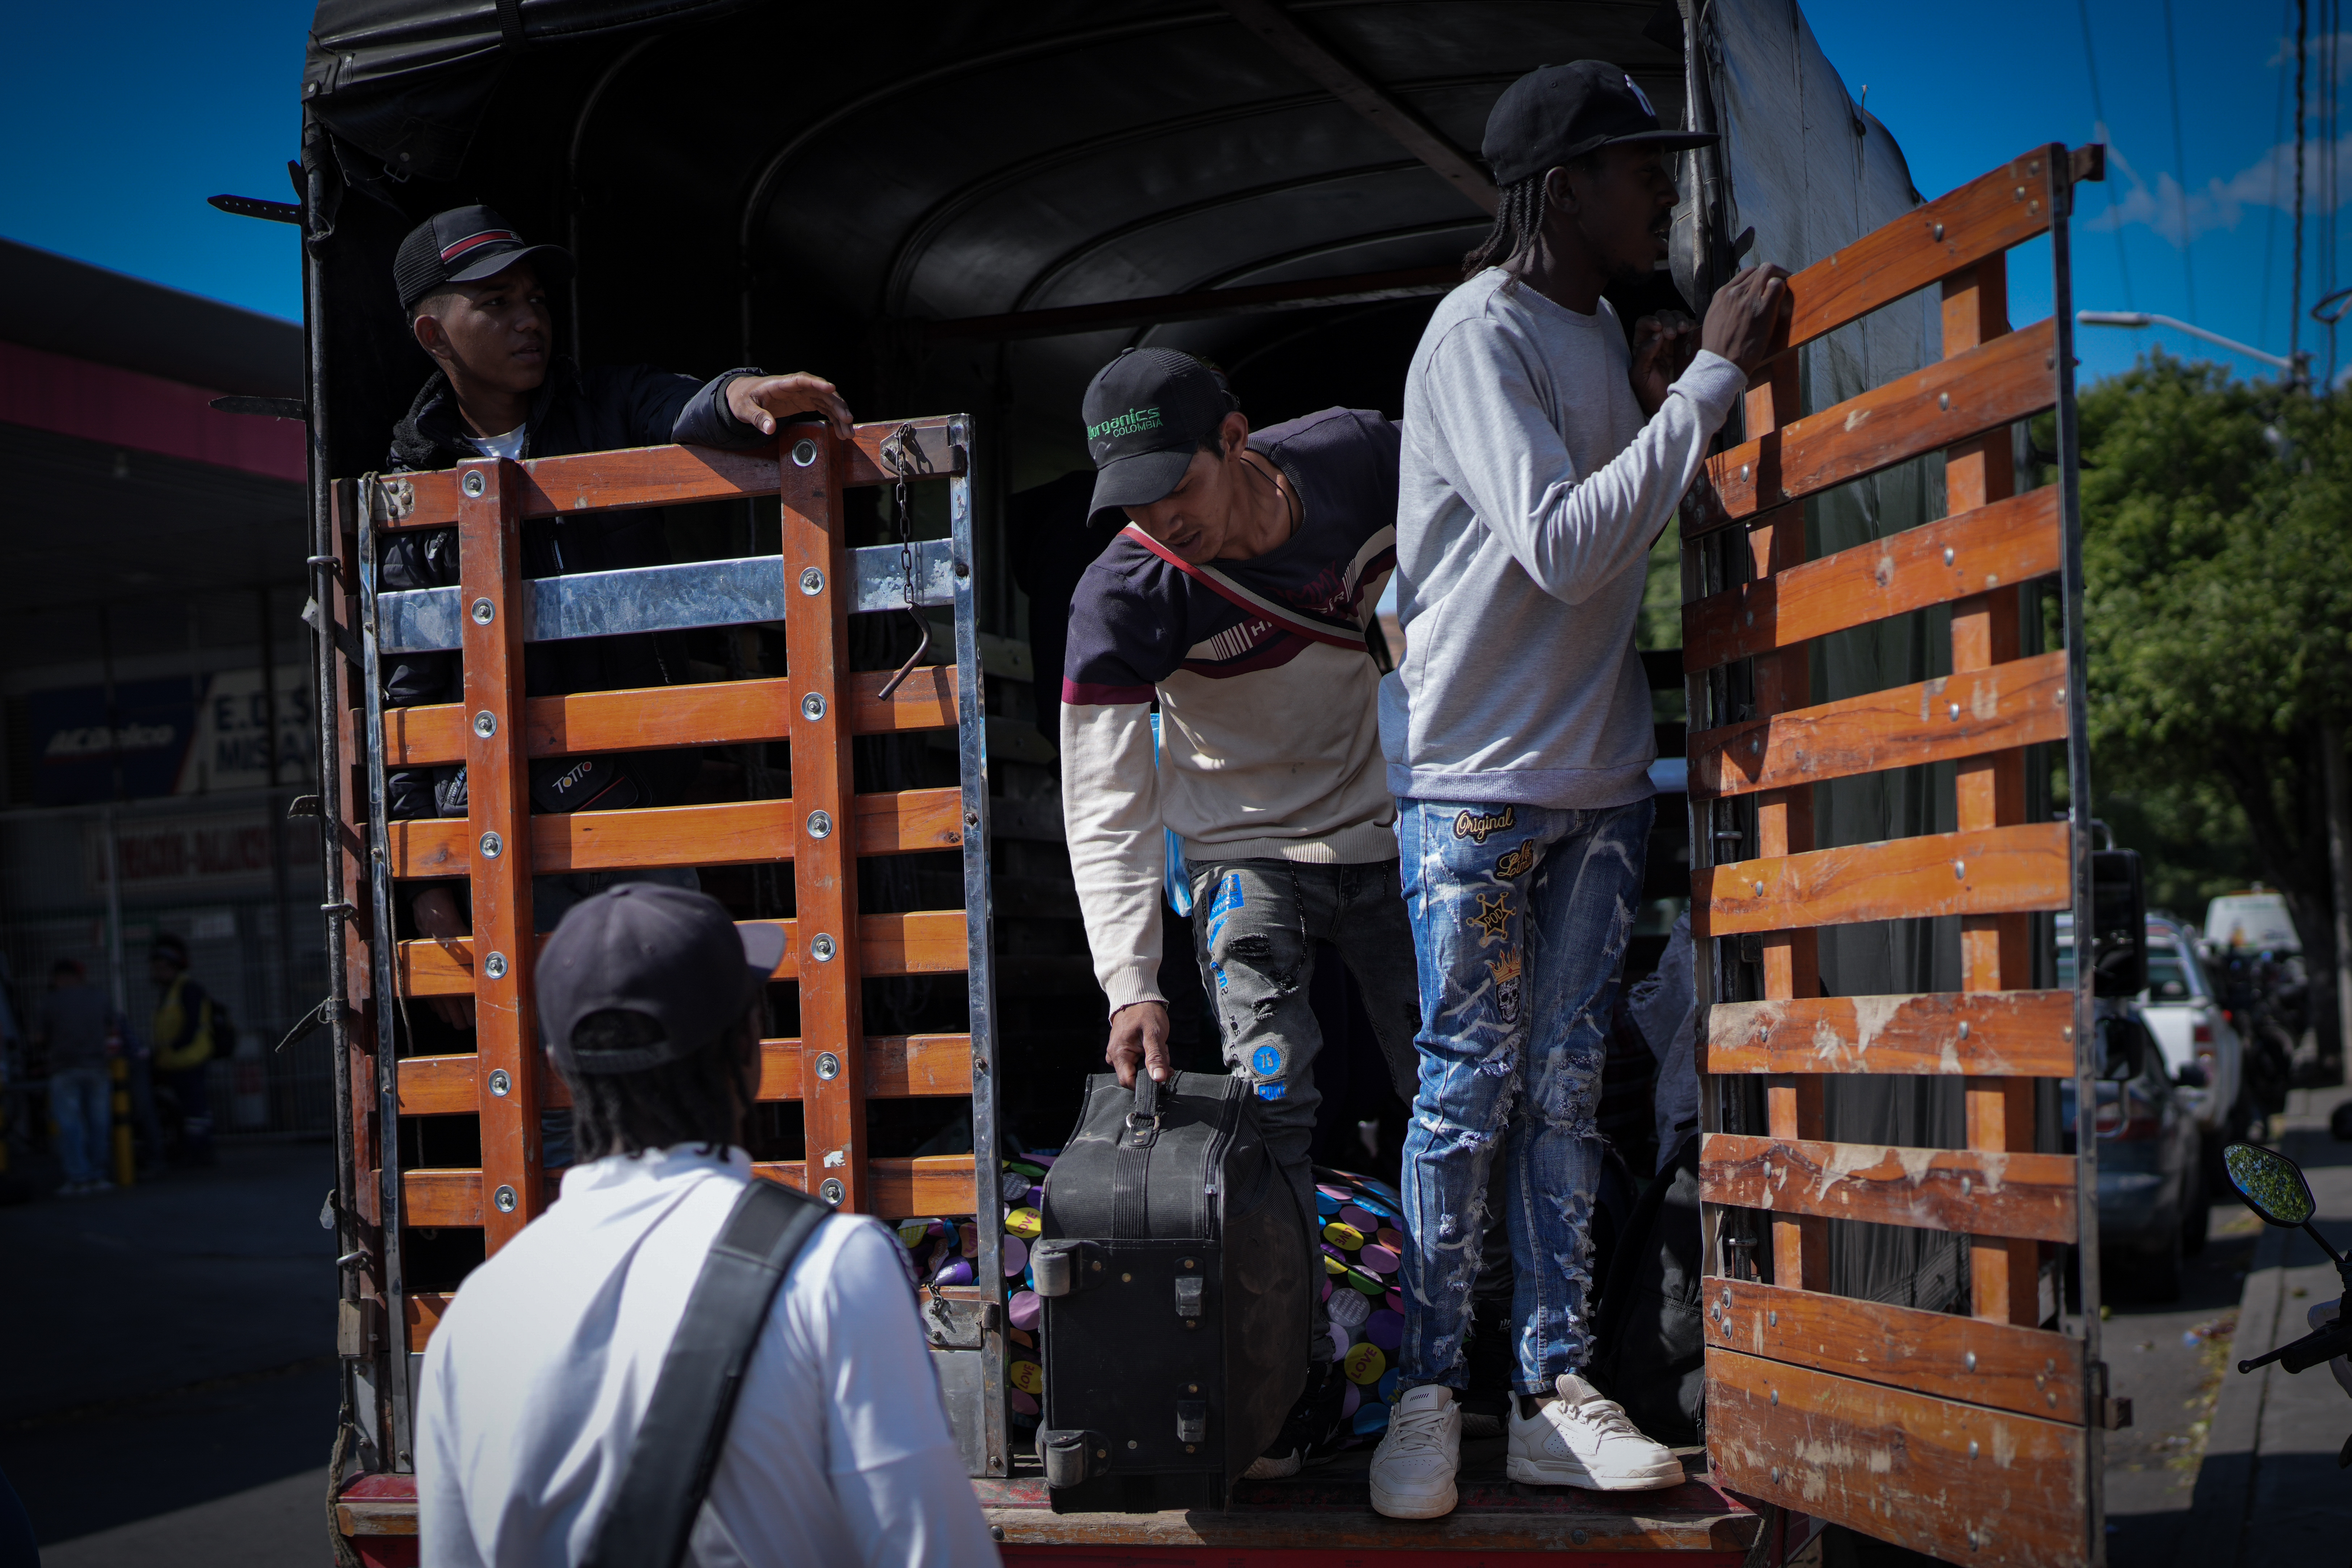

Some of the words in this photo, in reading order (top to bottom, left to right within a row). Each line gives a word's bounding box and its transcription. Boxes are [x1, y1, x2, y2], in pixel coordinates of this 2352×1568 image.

[1113, 418, 1164, 437] COLOMBIA
[552, 761, 592, 793] TOTTO
[1457, 807, 1513, 840] Original
[1484, 908, 1503, 928] POD
[1013, 1211, 1038, 1234] LOVE
[1335, 1228, 1355, 1245] LOVE
[1330, 1296, 1342, 1313] Love
[1336, 1289, 1356, 1316] beautiful
[1342, 1299, 1360, 1322] journey
[1351, 1347, 1377, 1379] LOVE
[1018, 1364, 1035, 1389] LOVE
